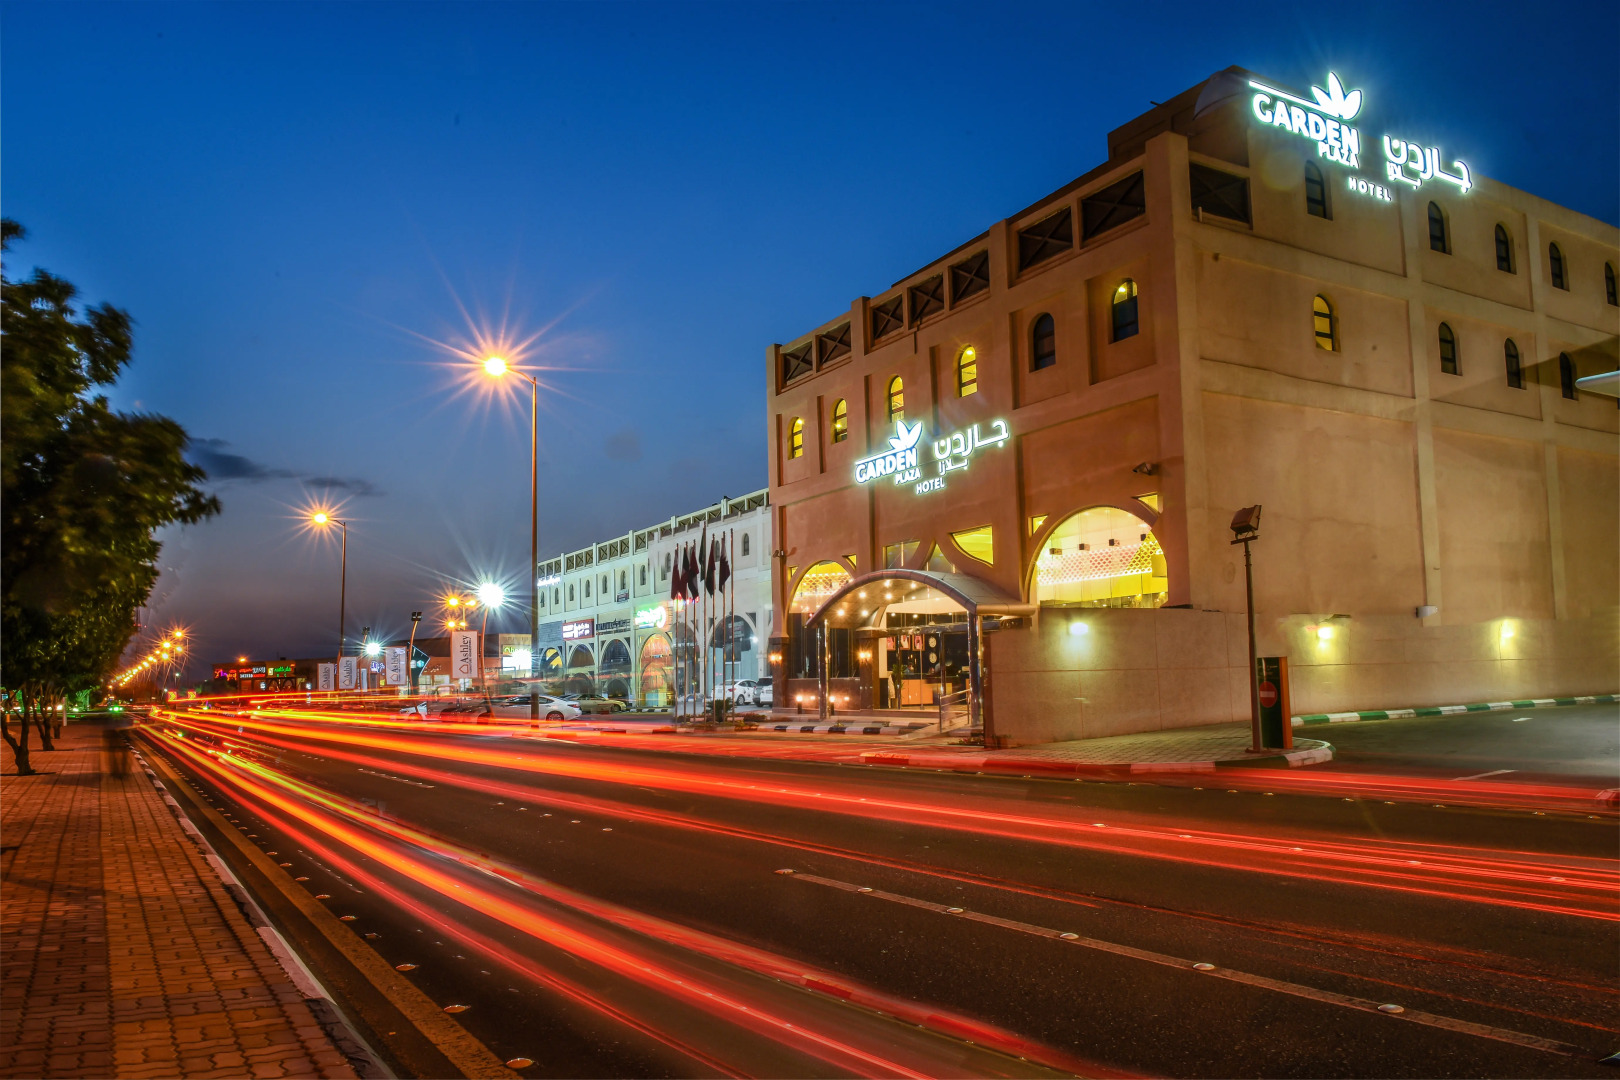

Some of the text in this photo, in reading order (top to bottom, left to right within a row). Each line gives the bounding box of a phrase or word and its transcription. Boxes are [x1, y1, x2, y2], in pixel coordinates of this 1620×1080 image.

[1252, 92, 1360, 154] GARDEN
[1318, 142, 1360, 169] PLAZA
[1384, 135, 1473, 193] جاردن
[1348, 177, 1392, 201] HOTEL
[933, 419, 1010, 460] جاردن
[855, 448, 918, 484] GARDEN
[895, 468, 922, 485] PLAZA
[938, 458, 969, 475] بلازا
[916, 477, 945, 495] HOTEL
[459, 635, 470, 664] Ashley
